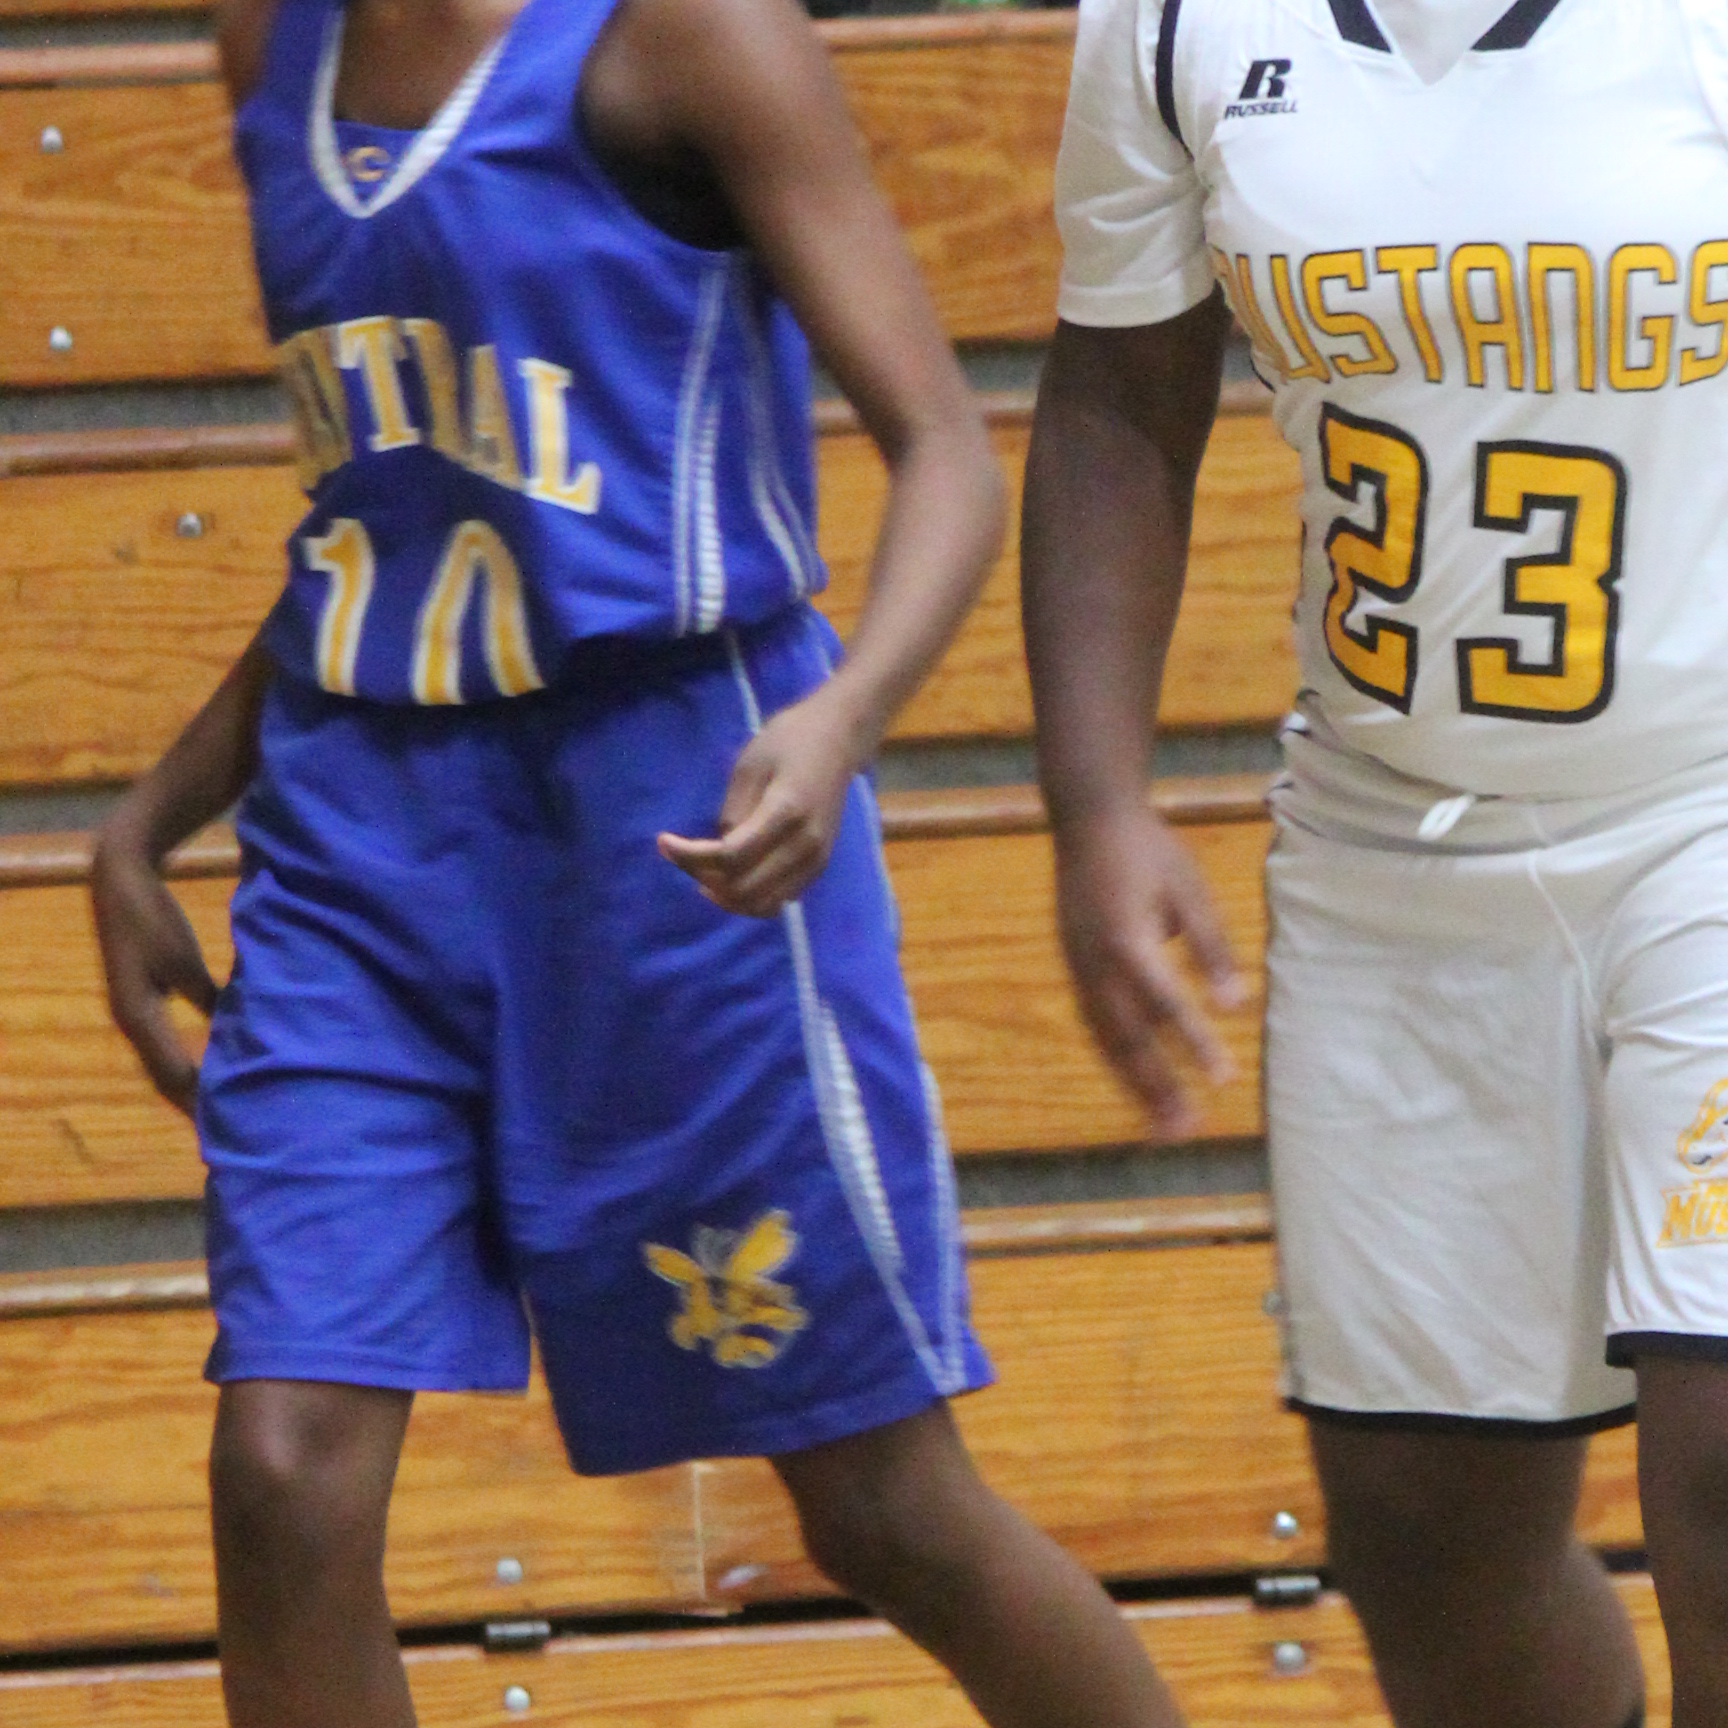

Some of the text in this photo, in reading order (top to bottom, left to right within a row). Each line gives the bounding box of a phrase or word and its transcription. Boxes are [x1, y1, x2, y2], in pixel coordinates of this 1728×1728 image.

[1239, 58, 1292, 99] R
[1223, 100, 1298, 120] RUSSELL
[1320, 402, 1629, 725] 23
